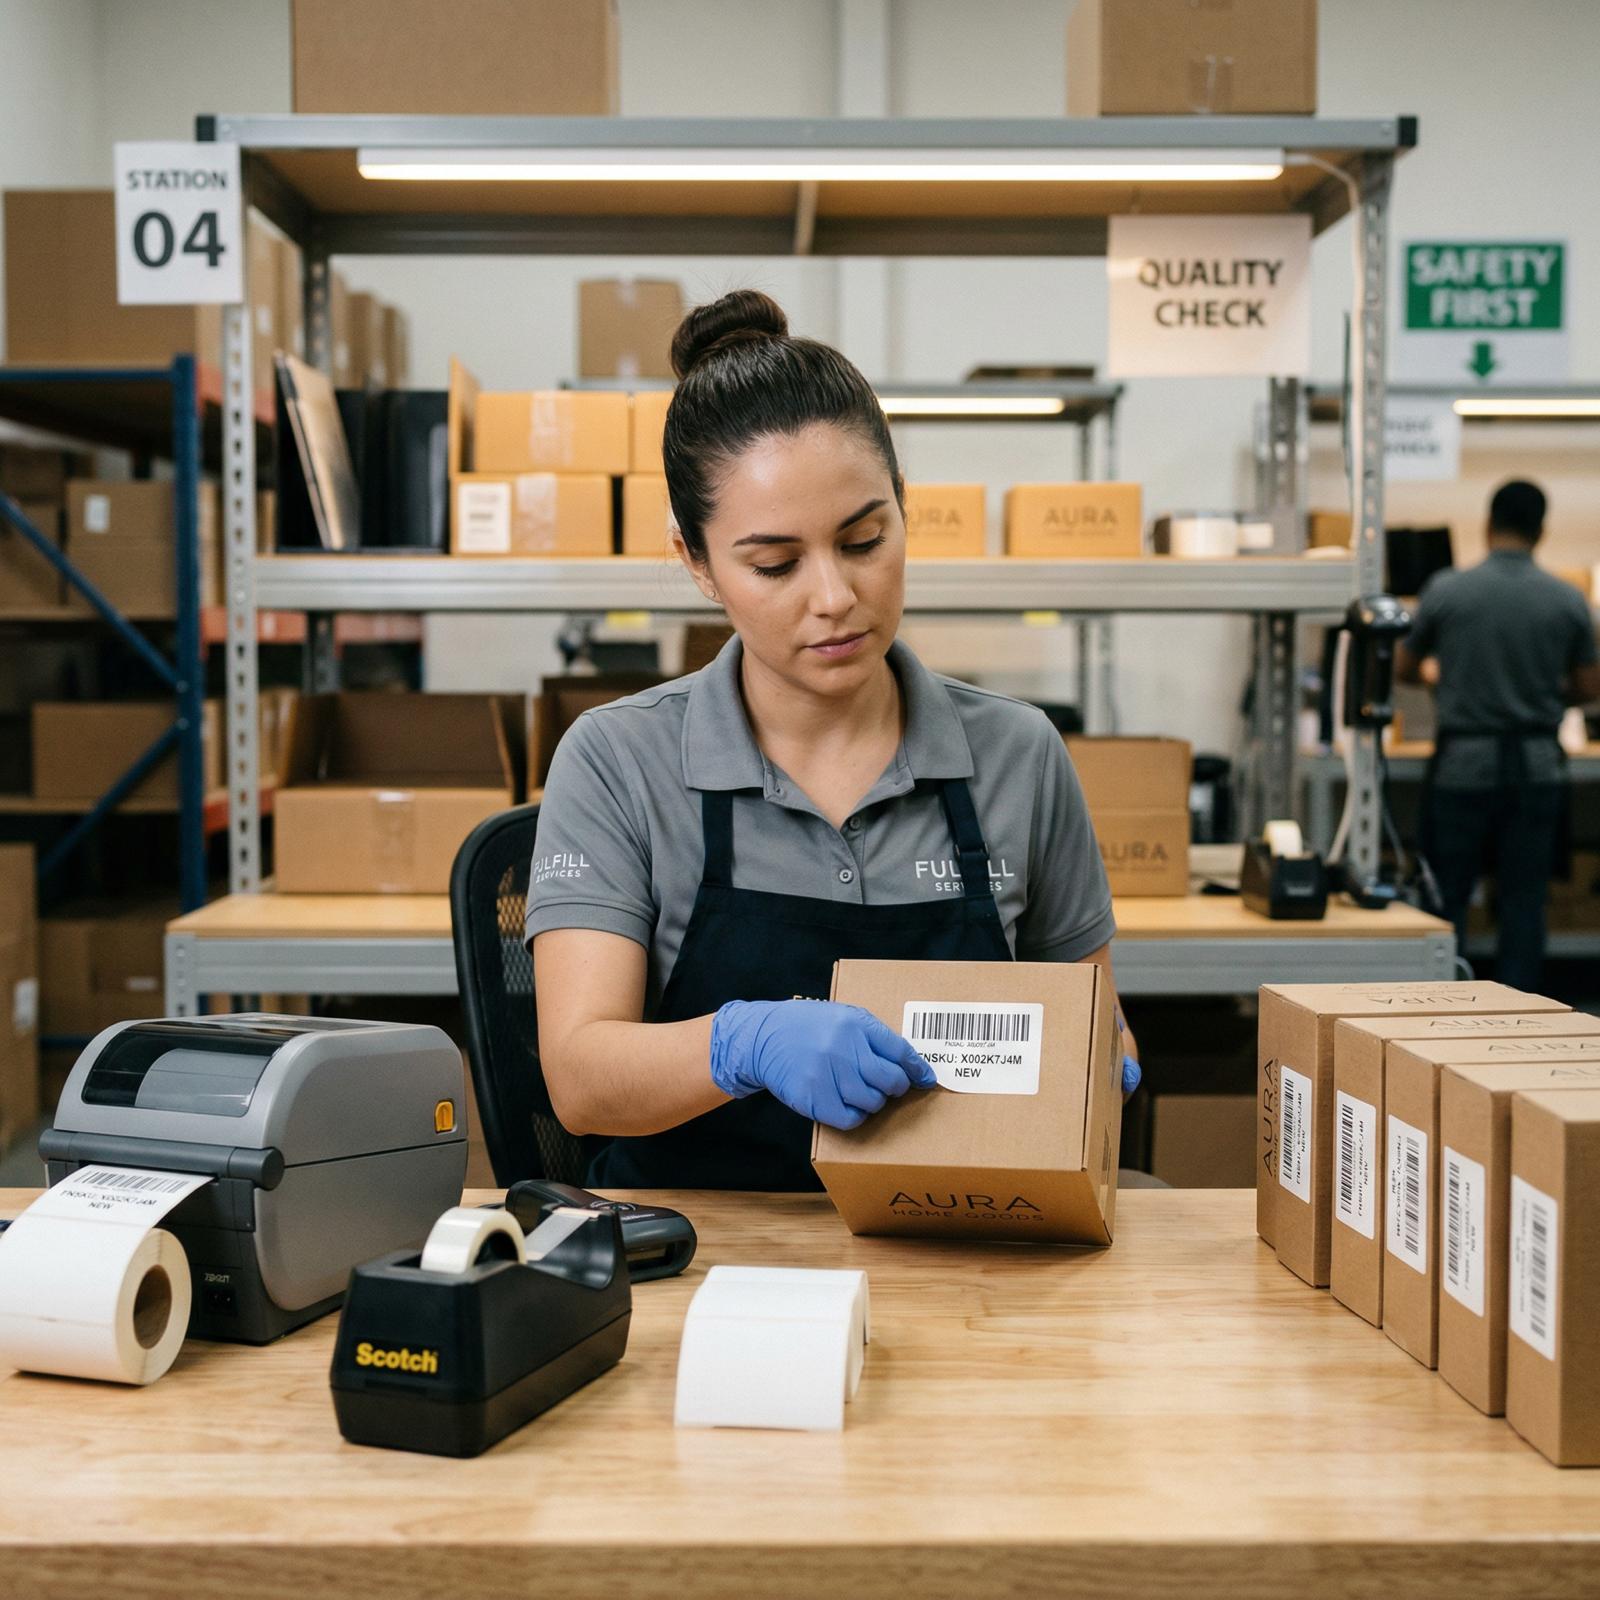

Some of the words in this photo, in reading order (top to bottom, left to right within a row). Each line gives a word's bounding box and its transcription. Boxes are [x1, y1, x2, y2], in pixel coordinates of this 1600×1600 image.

[127, 170, 227, 190] STATION
[133, 211, 225, 268] 04
[1138, 259, 1283, 290] QUALITY
[1412, 250, 1557, 285] SAFETY
[1155, 301, 1266, 327] CHECK
[1430, 288, 1538, 325] FIRST
[911, 508, 963, 528] URA
[1043, 506, 1119, 528] AURA
[915, 859, 1015, 879] FULLL
[935, 881, 1002, 892] SERES
[960, 1053, 1022, 1065] X002K7J4M
[954, 1067, 981, 1079] NEW
[1263, 1059, 1274, 1177] AURA
[888, 1191, 1042, 1212] AURA
[892, 1209, 953, 1217] HOME
[965, 1211, 1044, 1221] GOODS
[356, 1342, 438, 1373] Scotch
